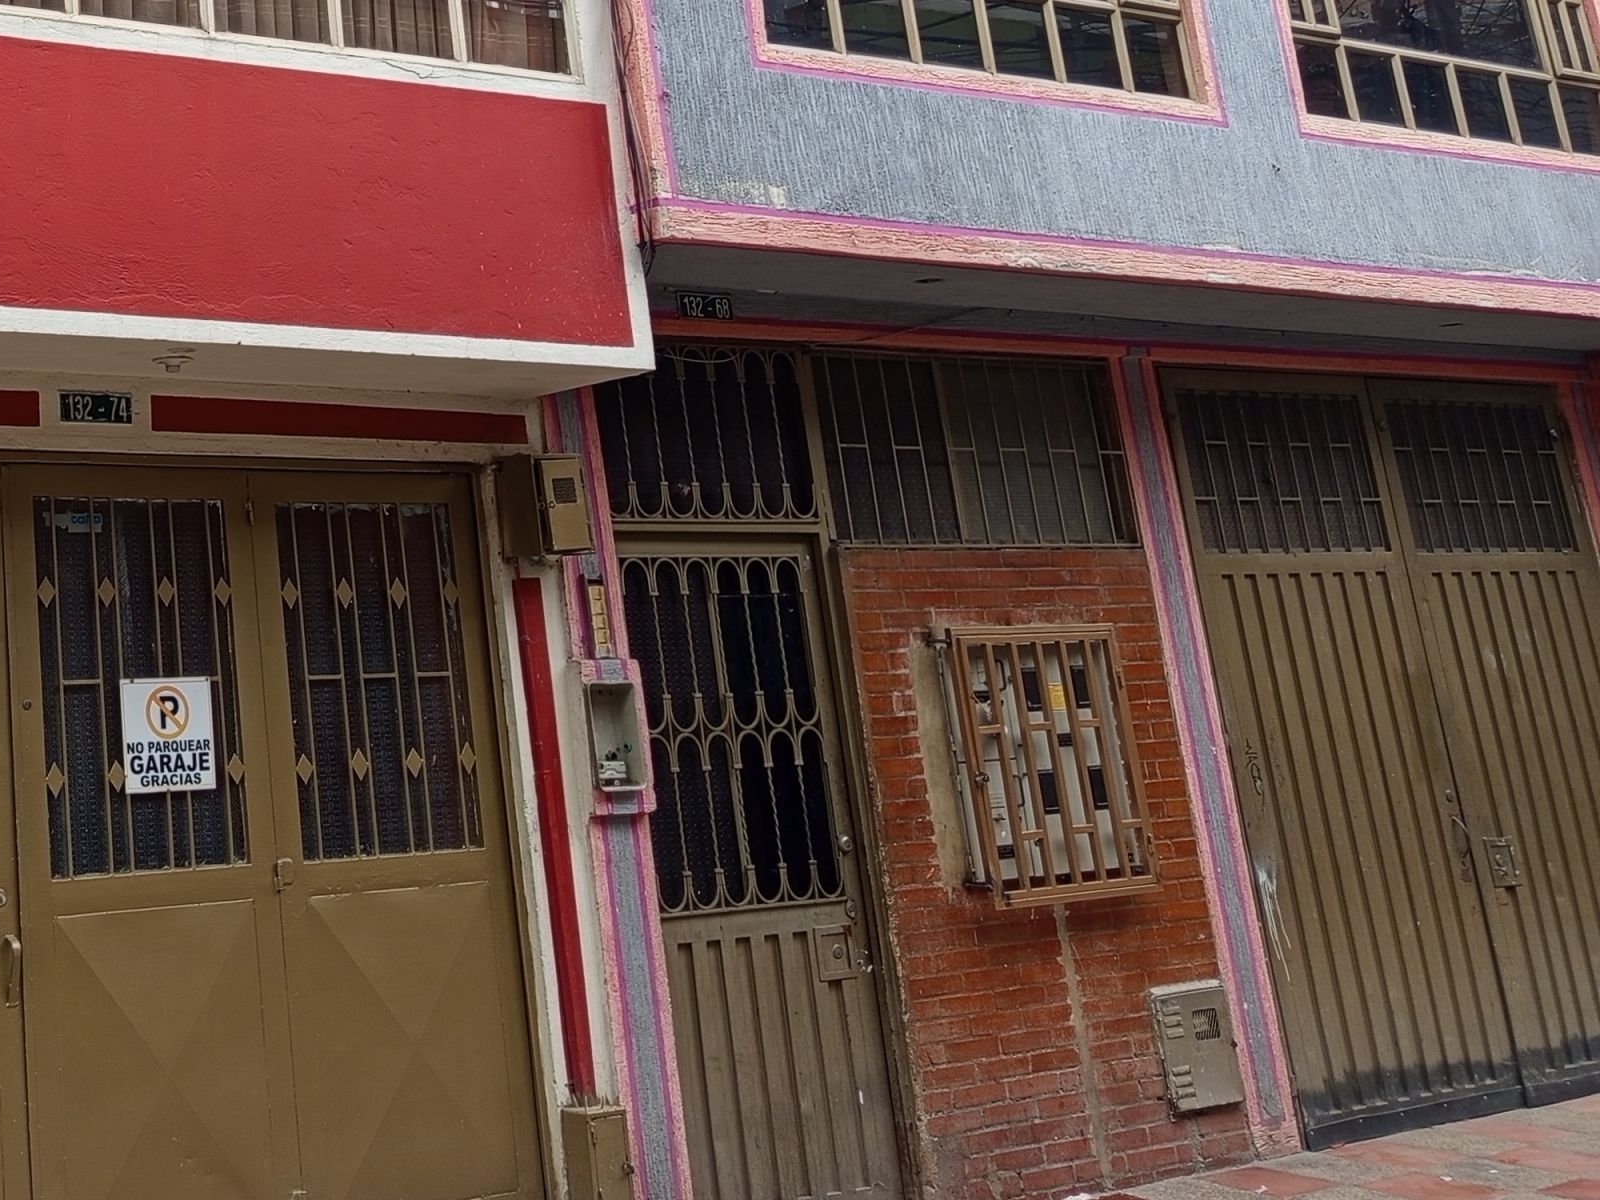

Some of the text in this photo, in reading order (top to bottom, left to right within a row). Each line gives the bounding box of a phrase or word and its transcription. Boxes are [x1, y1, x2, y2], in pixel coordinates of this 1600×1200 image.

[126, 739, 211, 755] NO PARQUEAR
[129, 752, 211, 775] GARAJE
[140, 772, 202, 788] GRACIAS
